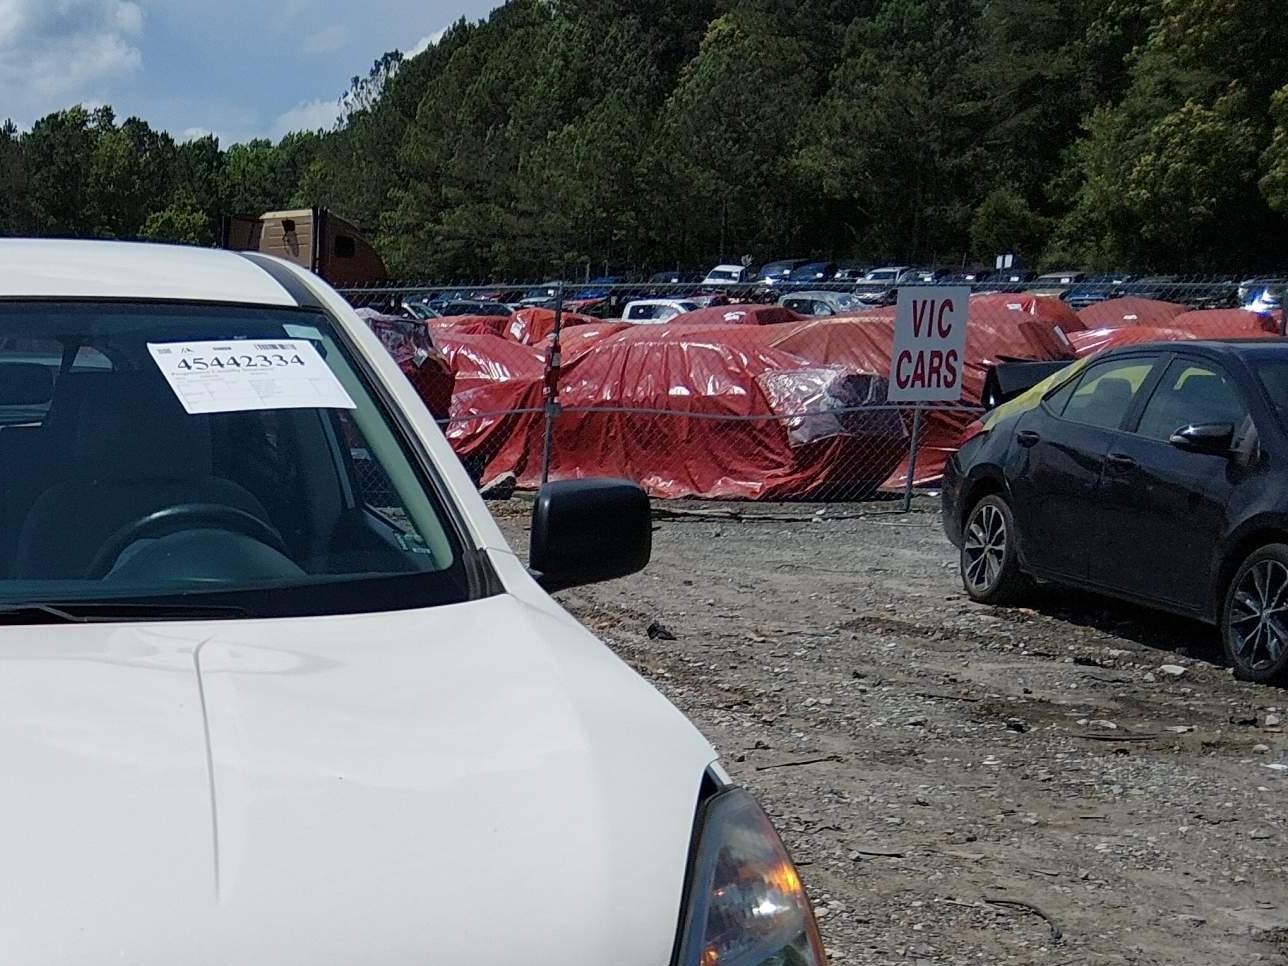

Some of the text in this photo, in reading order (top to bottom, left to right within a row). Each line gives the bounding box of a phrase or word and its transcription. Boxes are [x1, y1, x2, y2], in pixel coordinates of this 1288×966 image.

[912, 298, 954, 338] VIC
[177, 354, 305, 371] 45442334
[895, 348, 958, 389] CARS
